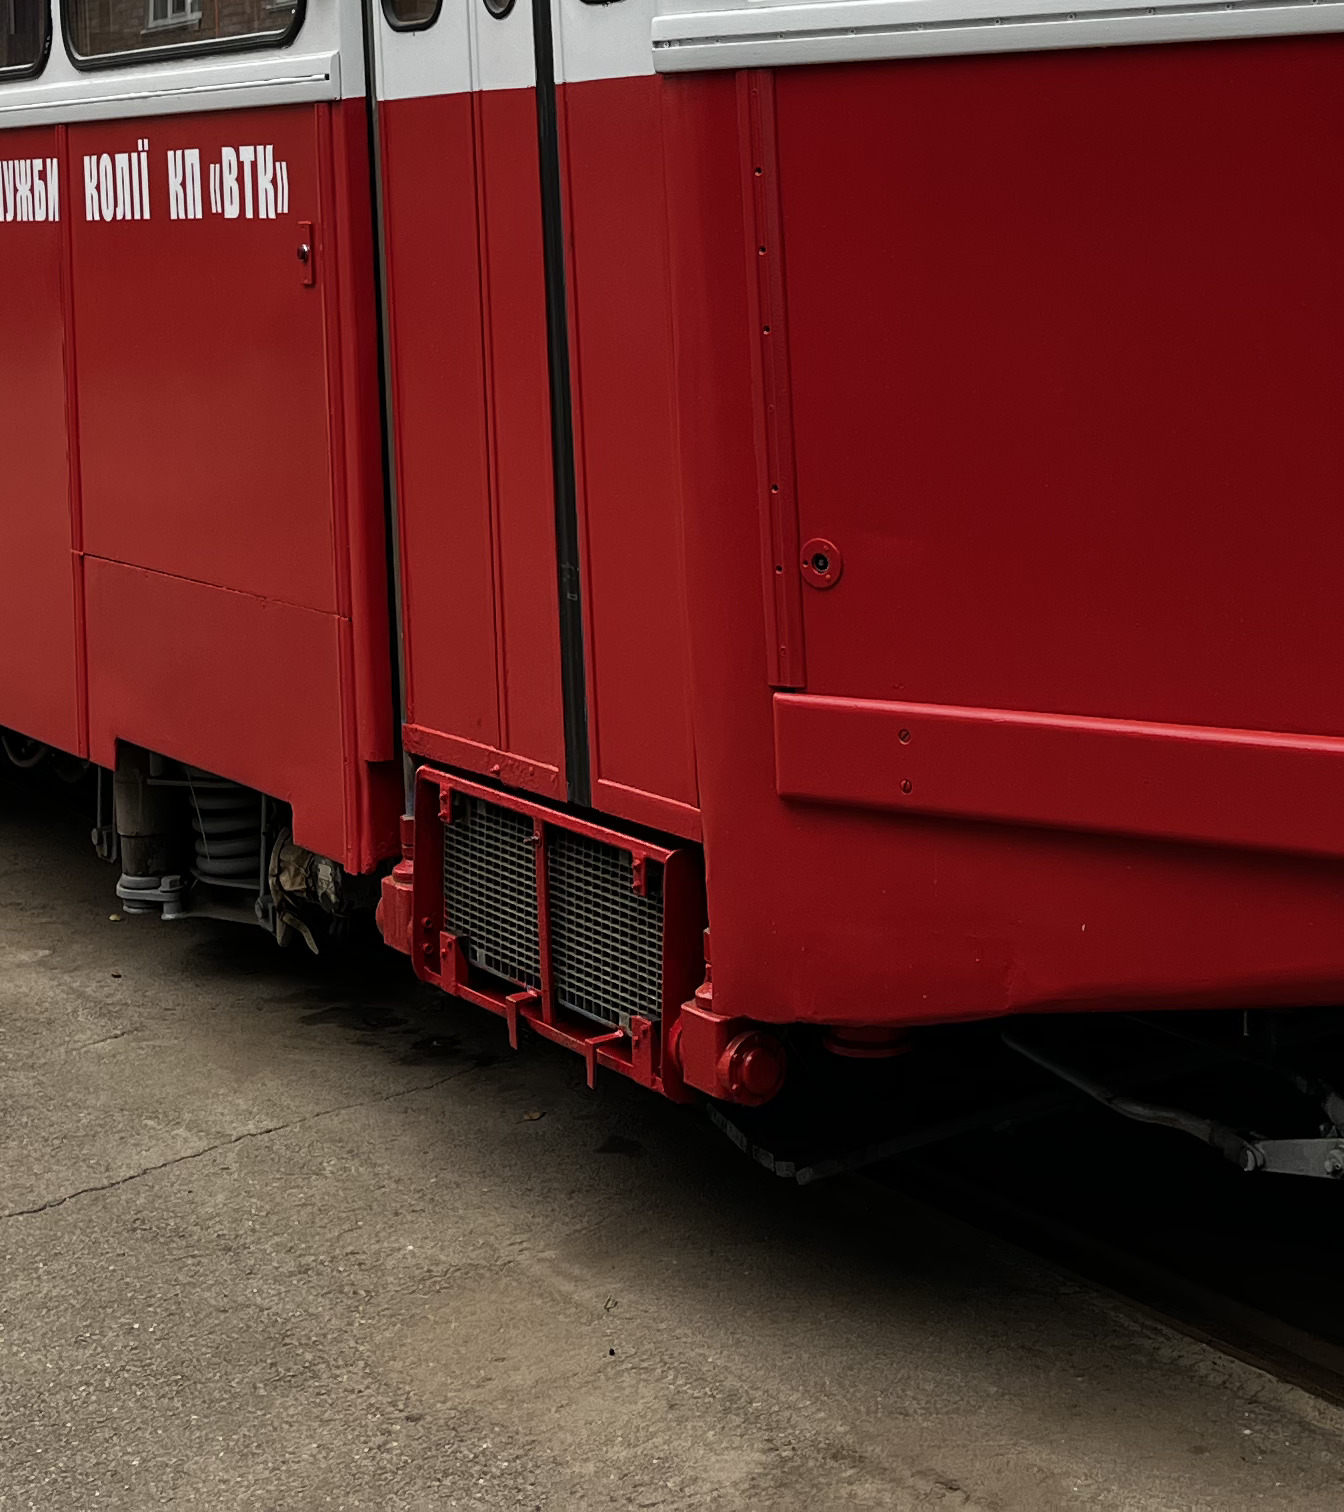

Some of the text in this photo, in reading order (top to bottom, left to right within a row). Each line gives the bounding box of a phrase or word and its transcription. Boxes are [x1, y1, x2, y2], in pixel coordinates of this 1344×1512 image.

[84, 139, 151, 222] КОЛІЇ
[167, 149, 203, 220] КП
[209, 145, 289, 219] «ВТК»
